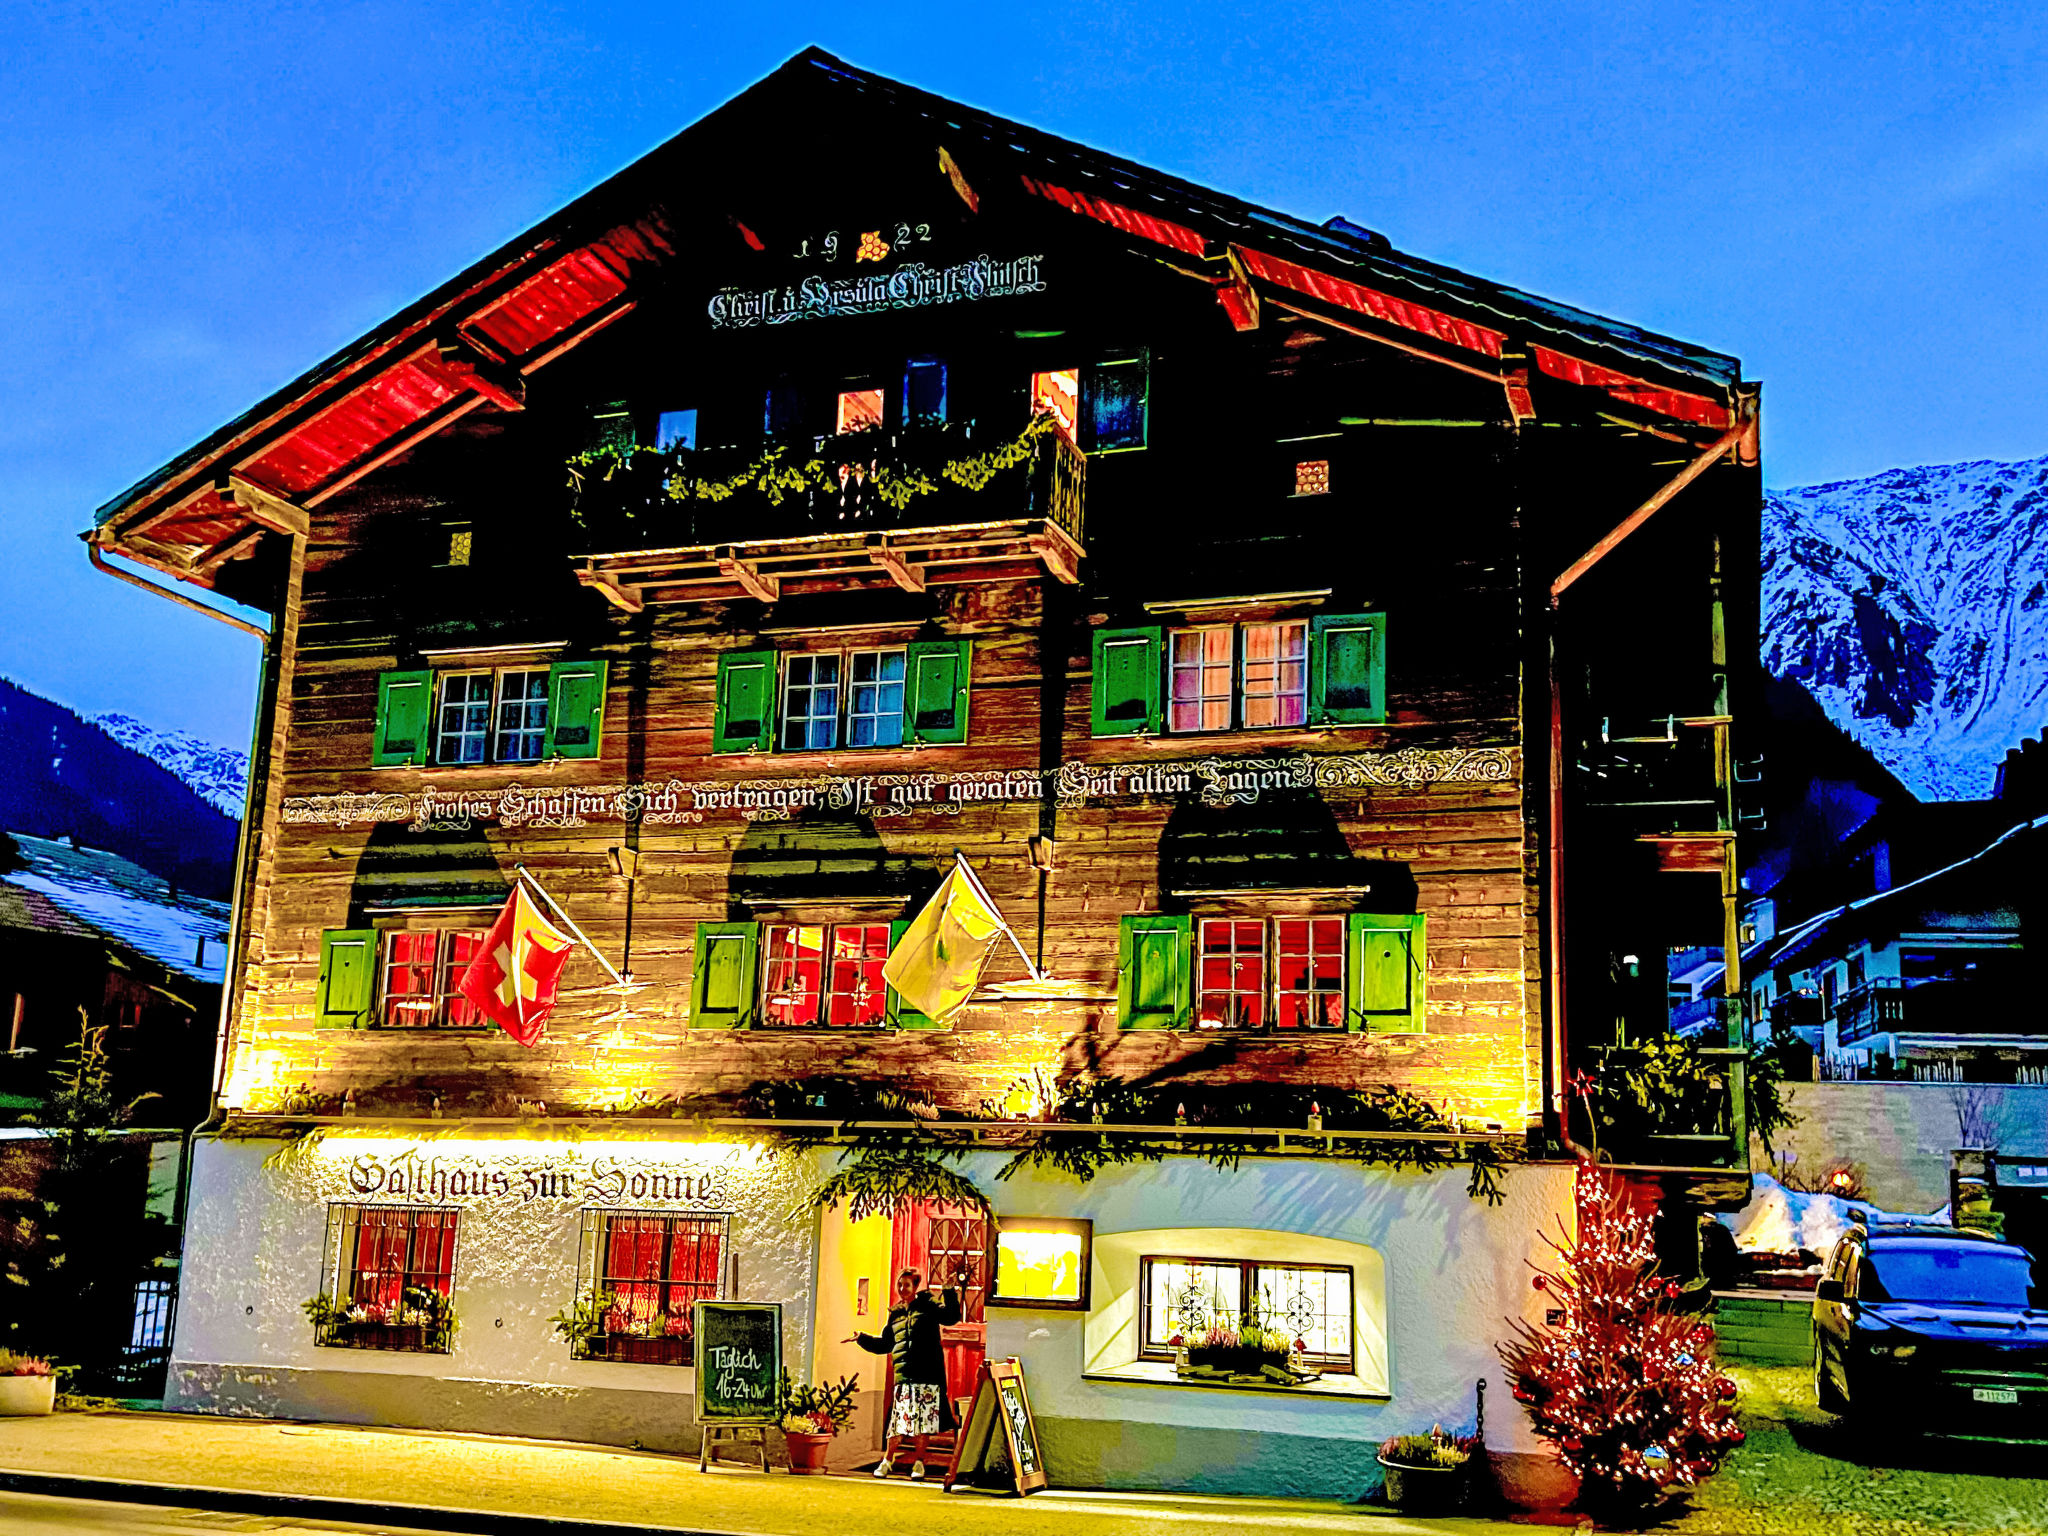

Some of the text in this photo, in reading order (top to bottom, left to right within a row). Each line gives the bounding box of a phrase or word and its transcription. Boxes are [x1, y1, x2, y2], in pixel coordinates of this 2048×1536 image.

[416, 785, 492, 824] Frohes
[614, 779, 679, 820] Sich
[828, 776, 878, 815] Ist
[890, 778, 935, 812] gut
[948, 775, 1044, 813] geraten
[1056, 761, 1119, 806] Seit
[1128, 763, 1191, 795] alten
[349, 1150, 726, 1206] Gasthaus zur Sonne
